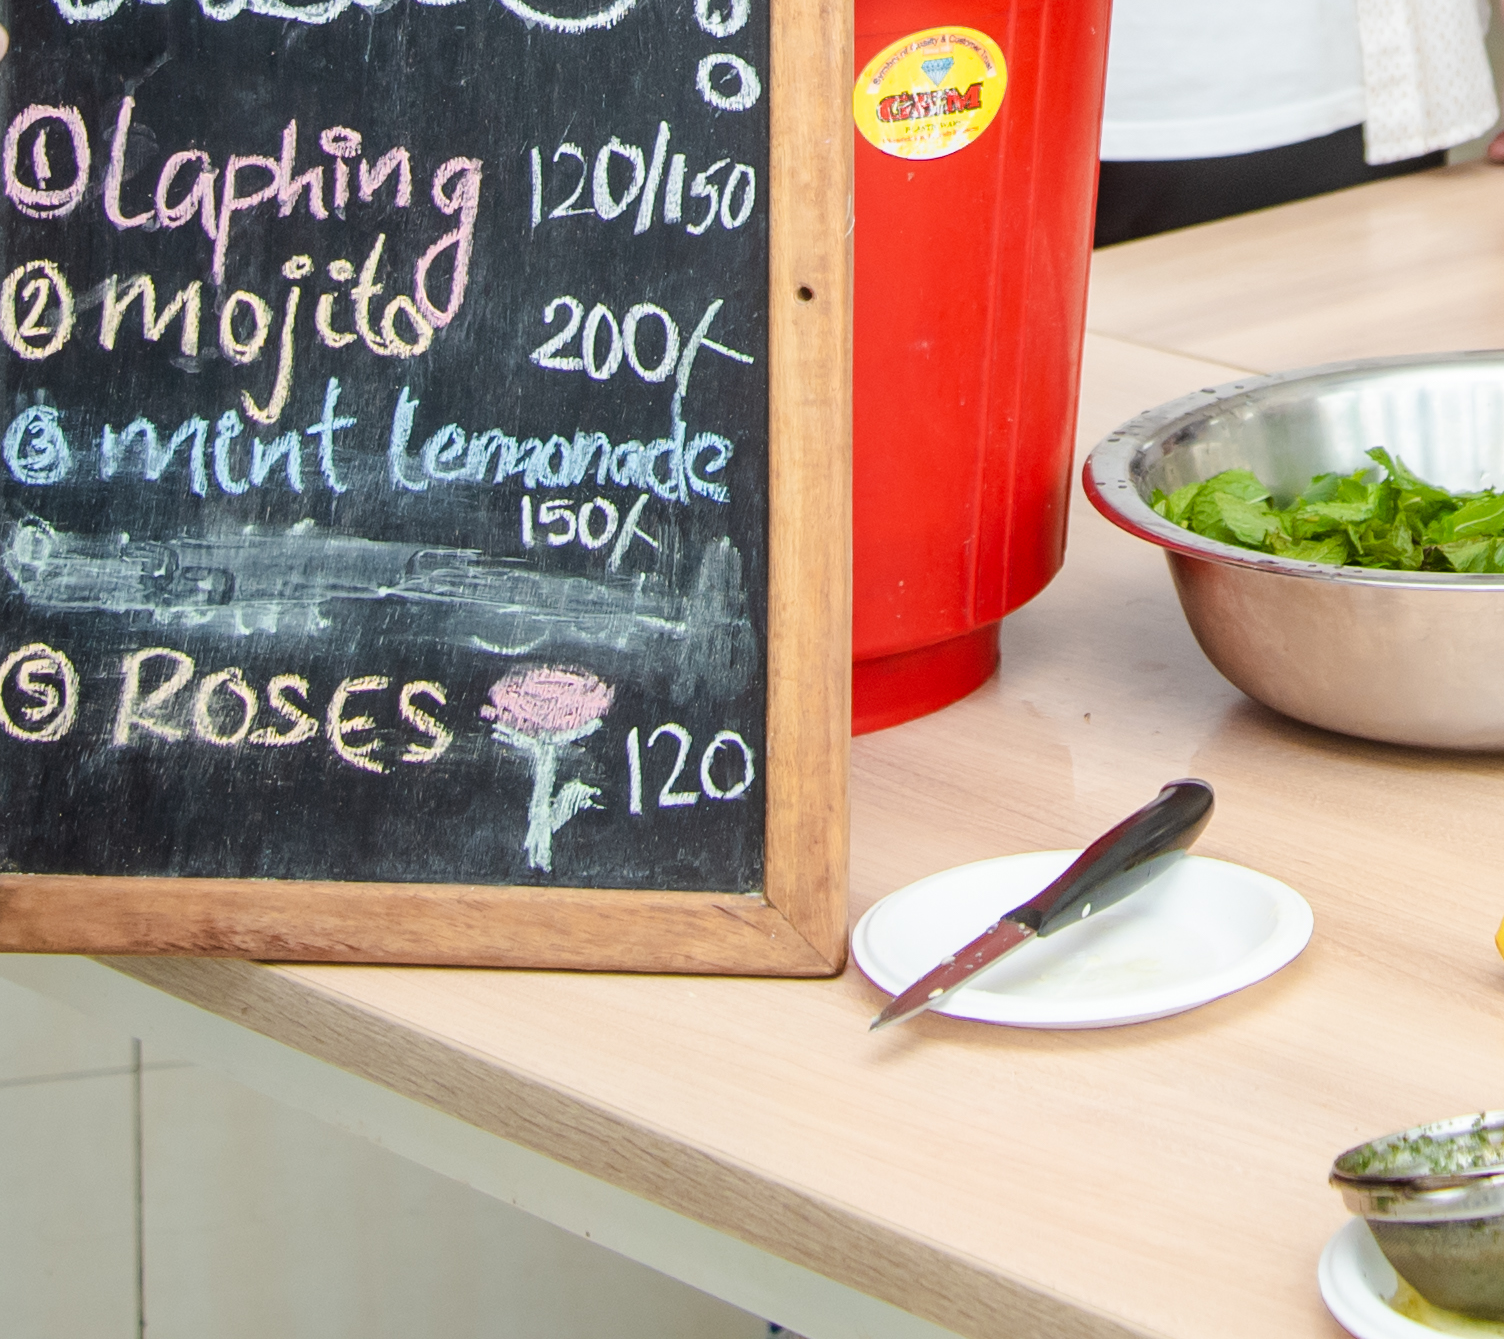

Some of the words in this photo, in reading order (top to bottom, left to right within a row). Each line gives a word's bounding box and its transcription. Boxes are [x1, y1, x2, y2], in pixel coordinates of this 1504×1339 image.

[529, 121, 756, 235] 120/150
[113, 646, 454, 774] ROSES
[625, 723, 756, 815] 120
